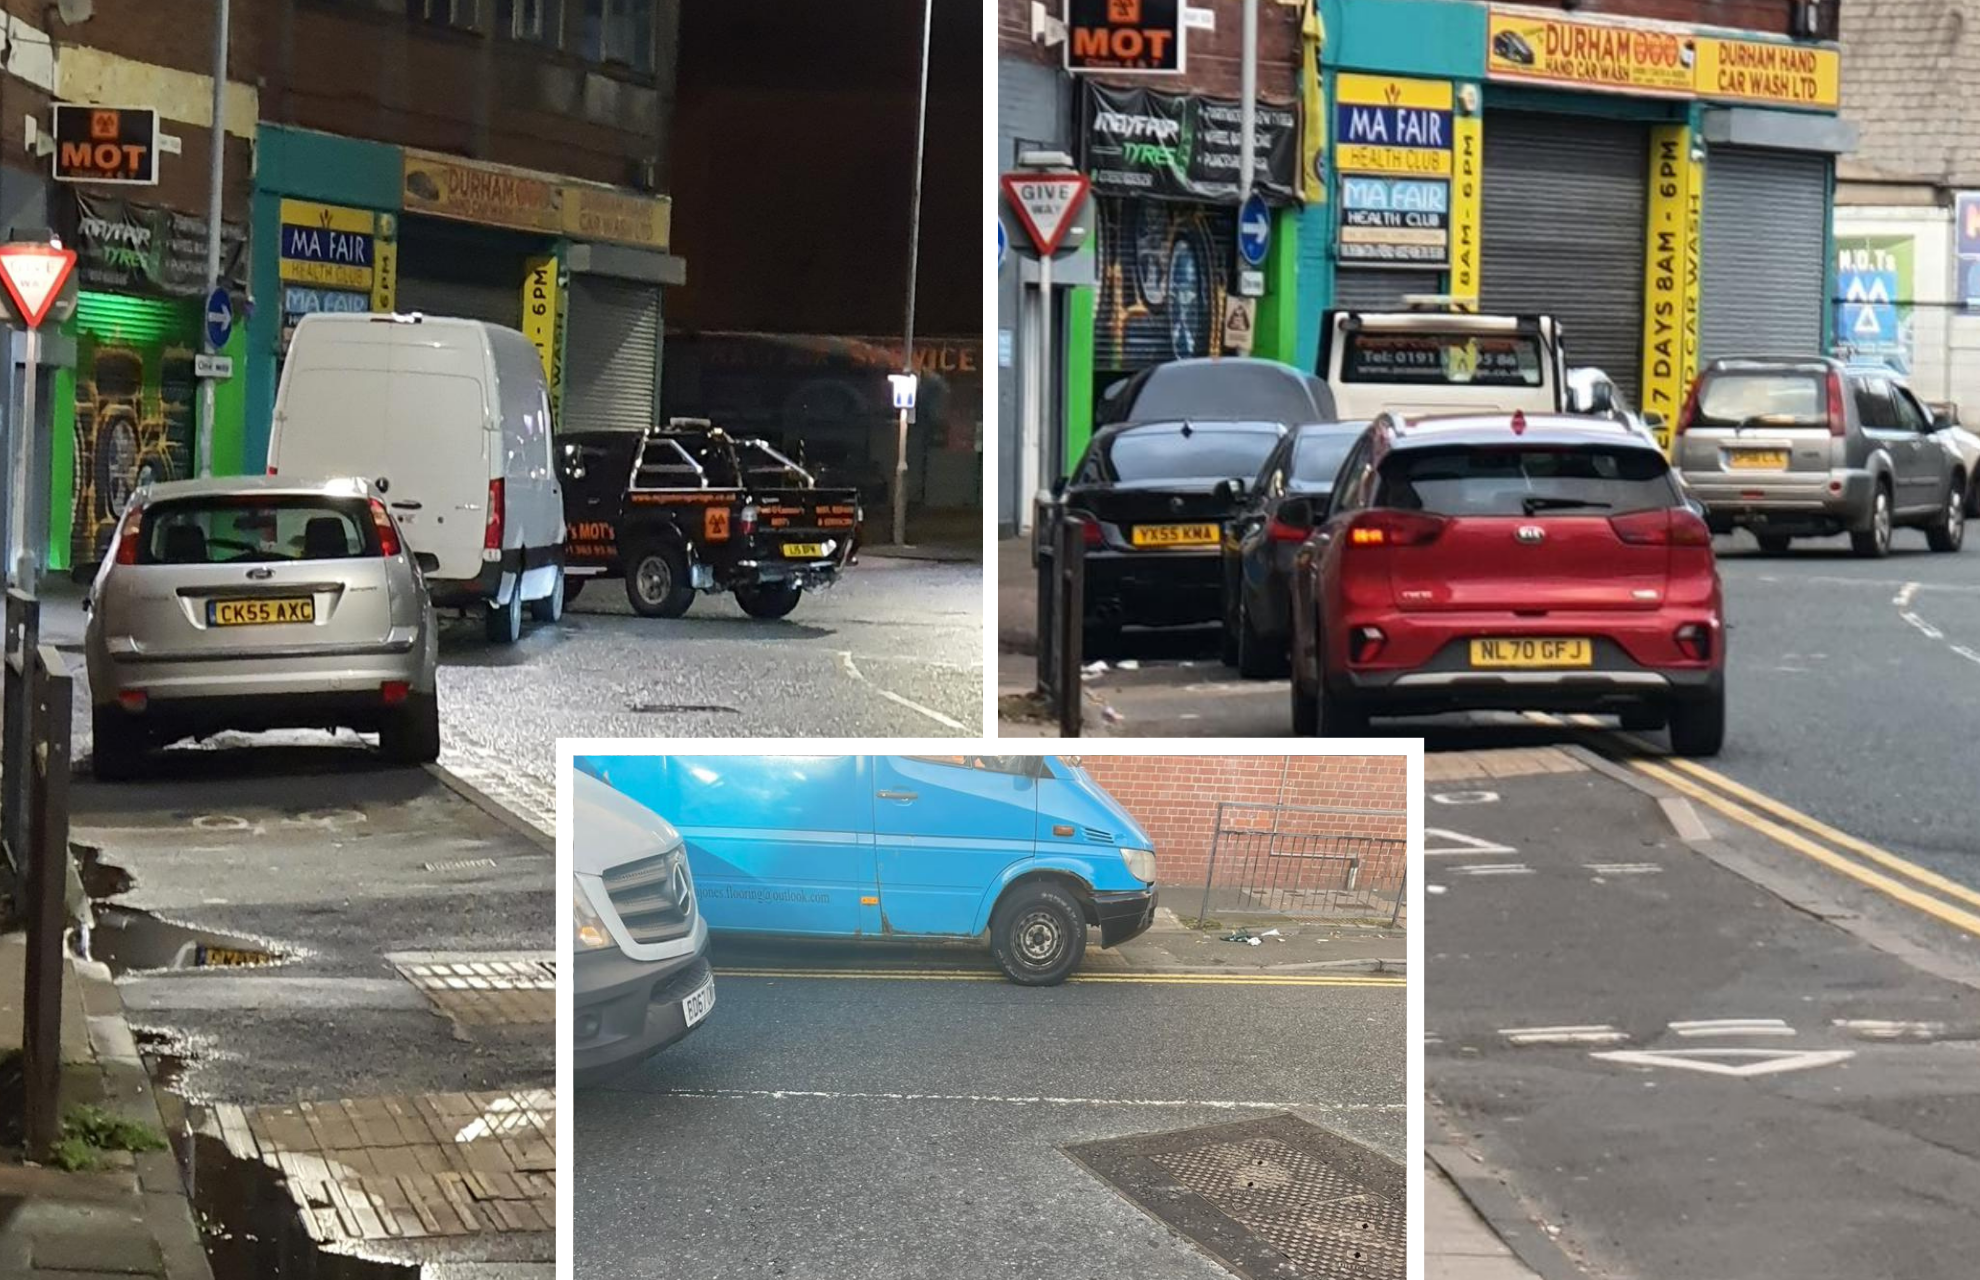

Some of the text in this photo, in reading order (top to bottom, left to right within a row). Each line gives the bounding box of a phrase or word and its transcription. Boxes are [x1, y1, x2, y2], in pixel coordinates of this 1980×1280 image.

[1074, 27, 1172, 59] MOT
[1546, 23, 1630, 65] DURHAM
[1718, 42, 1817, 73] DURHAM HAND
[1546, 57, 1573, 75] HAND
[1577, 61, 1598, 80] CAR
[1601, 65, 1629, 82] WASH
[1717, 69, 1745, 93] CAR
[1749, 72, 1789, 97] WASH
[1793, 75, 1817, 99] LTD
[1349, 107, 1442, 145] MA FAIR
[62, 142, 147, 171] MOT
[1351, 147, 1440, 170] HEALTH CLUB
[1660, 141, 1678, 198] 6PM
[449, 167, 520, 207] DURHAM
[1021, 185, 1069, 200] GIVE
[1391, 184, 1443, 212] FAIR
[1348, 210, 1439, 227] HEALTH CLUB
[291, 229, 365, 263] MA FAIR
[1686, 194, 1699, 286] WASH
[291, 263, 364, 285] HEALTH CLUB
[1656, 232, 1675, 291] 8AM
[532, 269, 548, 316] 6PM
[1653, 301, 1673, 378] DAYS
[1685, 297, 1697, 356] CAR
[1363, 351, 1392, 363] Tel:
[1396, 351, 1435, 364] 0191
[1652, 388, 1671, 403] 7
[221, 602, 312, 622] CK55 AXC
[1481, 641, 1535, 660] NL70
